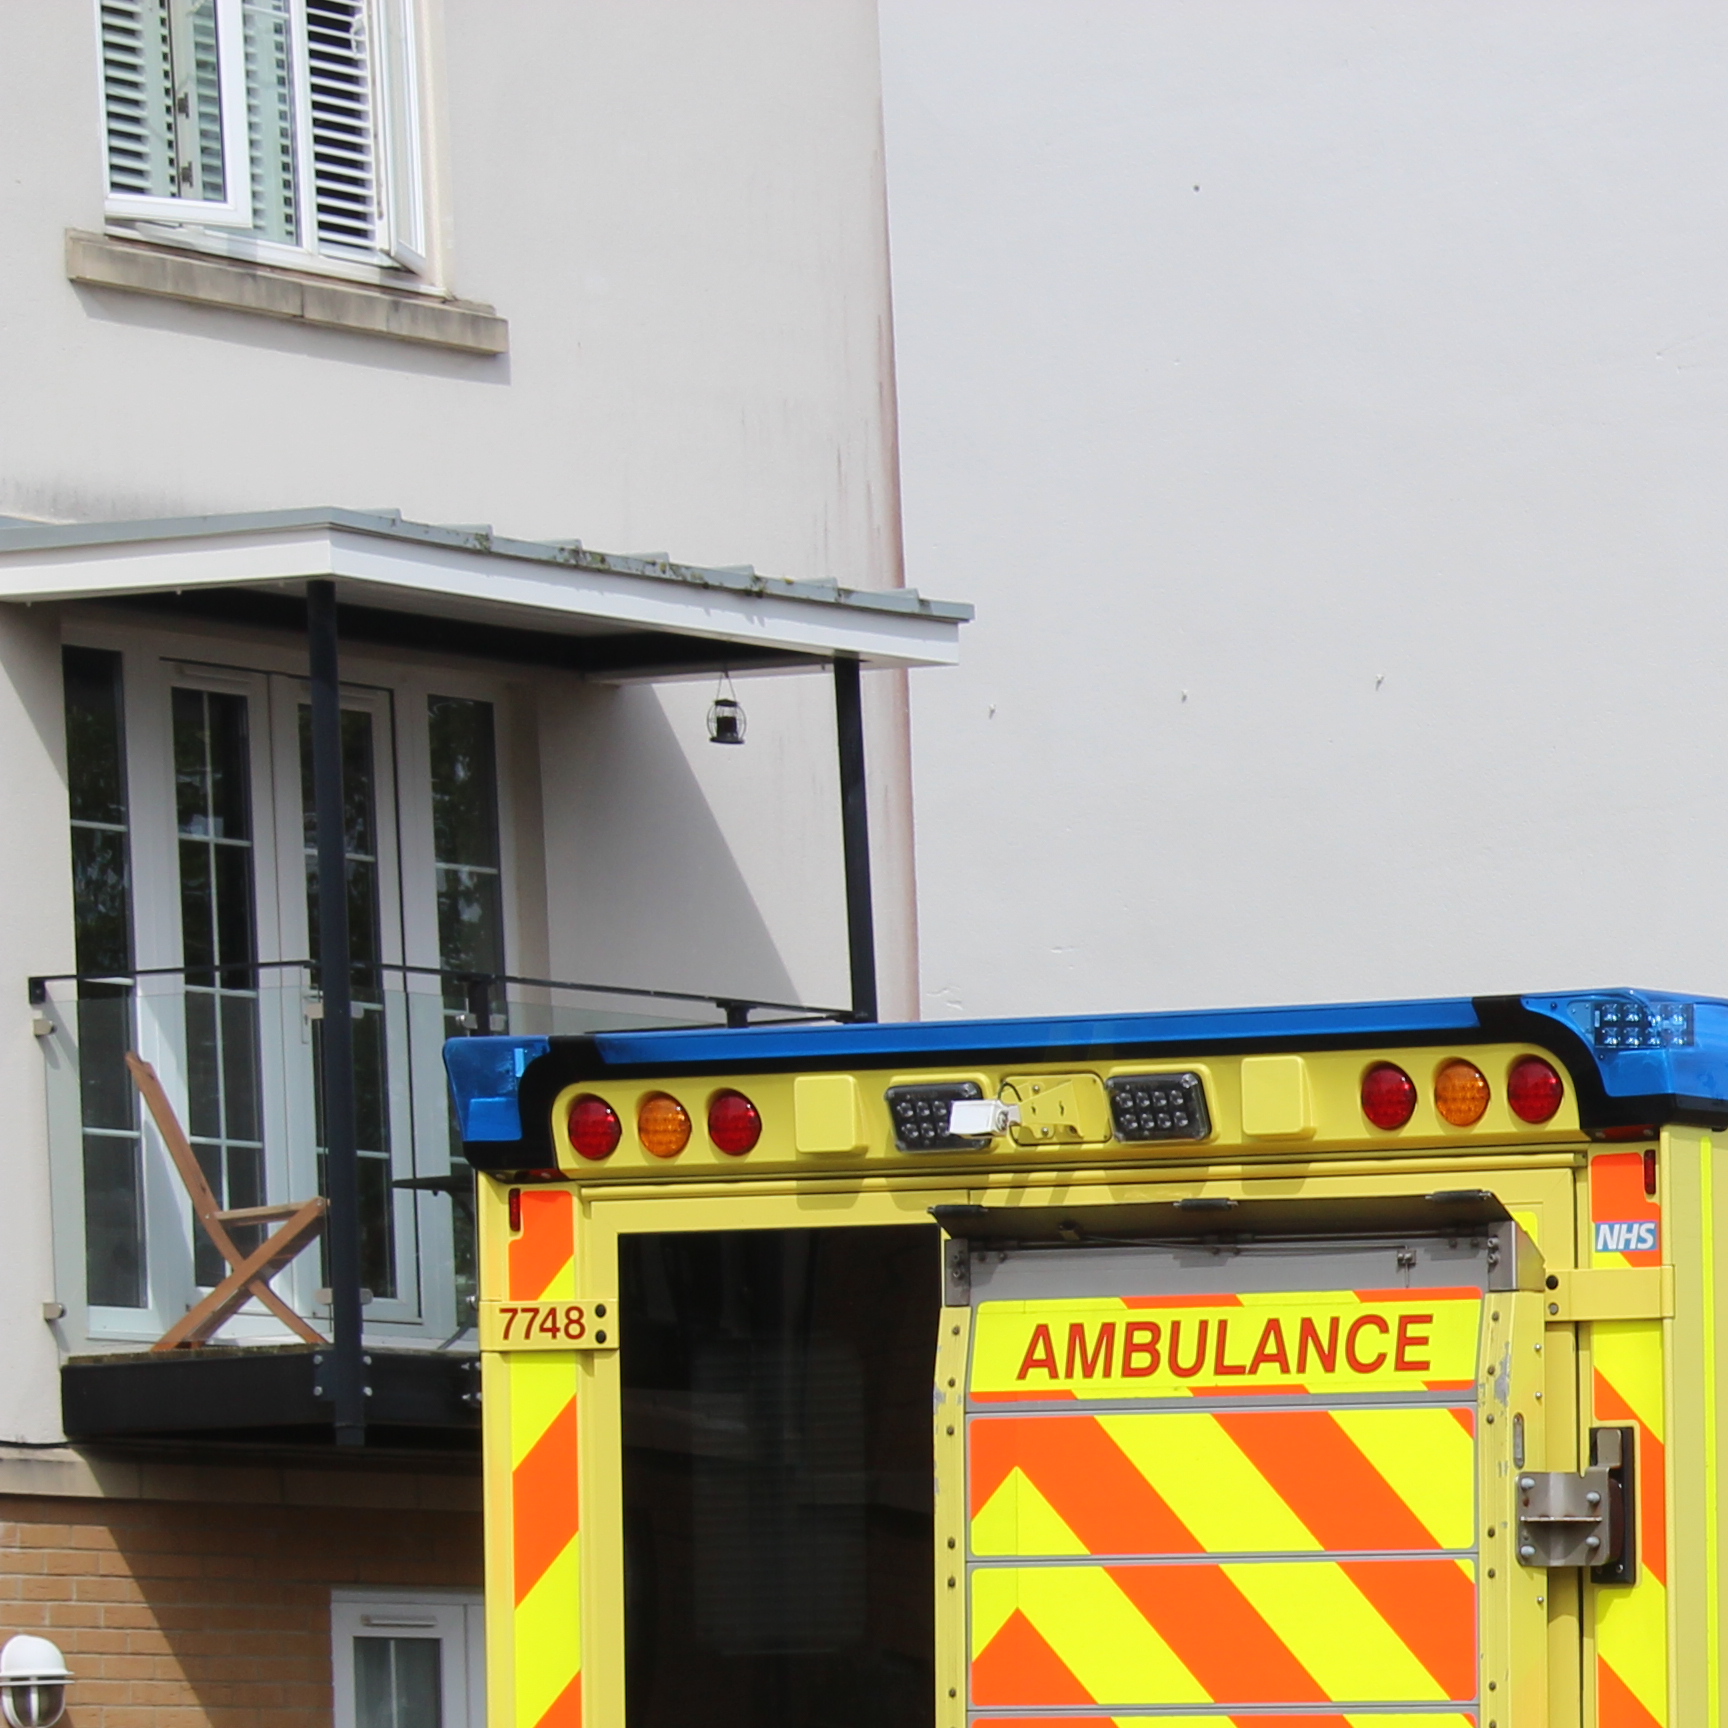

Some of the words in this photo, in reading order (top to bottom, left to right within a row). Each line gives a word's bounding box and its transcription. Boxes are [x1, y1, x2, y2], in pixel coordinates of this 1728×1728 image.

[1597, 1222, 1656, 1250] NHS
[499, 1306, 586, 1340] 7748
[1016, 1313, 1433, 1380] AMBULANCE
